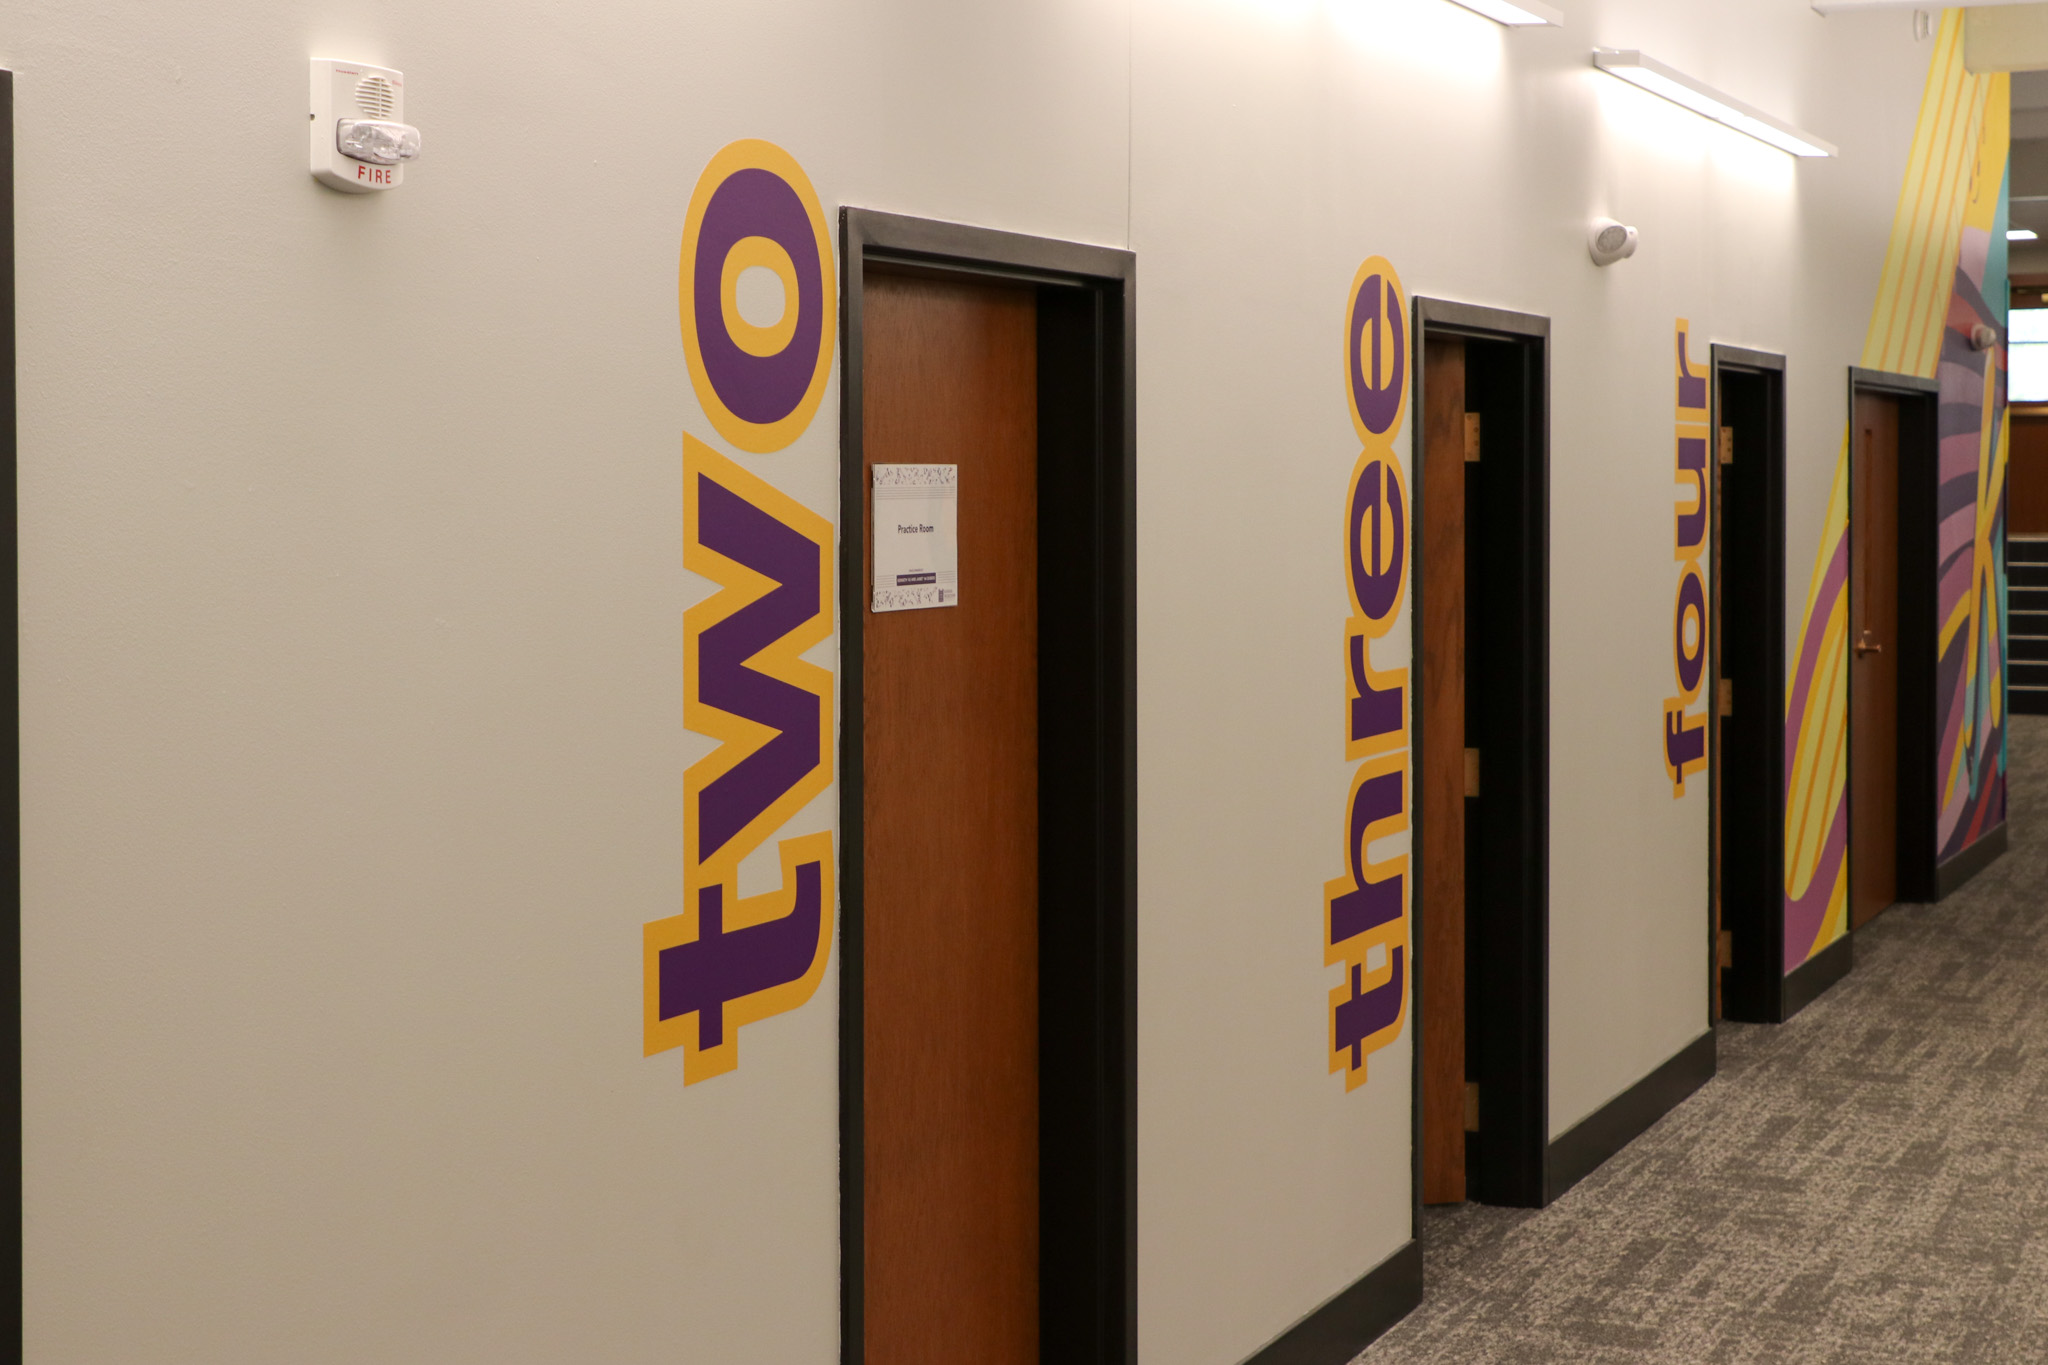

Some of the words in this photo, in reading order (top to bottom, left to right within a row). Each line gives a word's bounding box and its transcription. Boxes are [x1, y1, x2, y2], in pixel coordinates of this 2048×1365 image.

[358, 164, 392, 184] FIRE
[643, 139, 841, 1086] two
[897, 524, 918, 534] Practice
[919, 523, 934, 533] Room
[1324, 256, 1413, 1093] three
[1663, 319, 1711, 797] four
